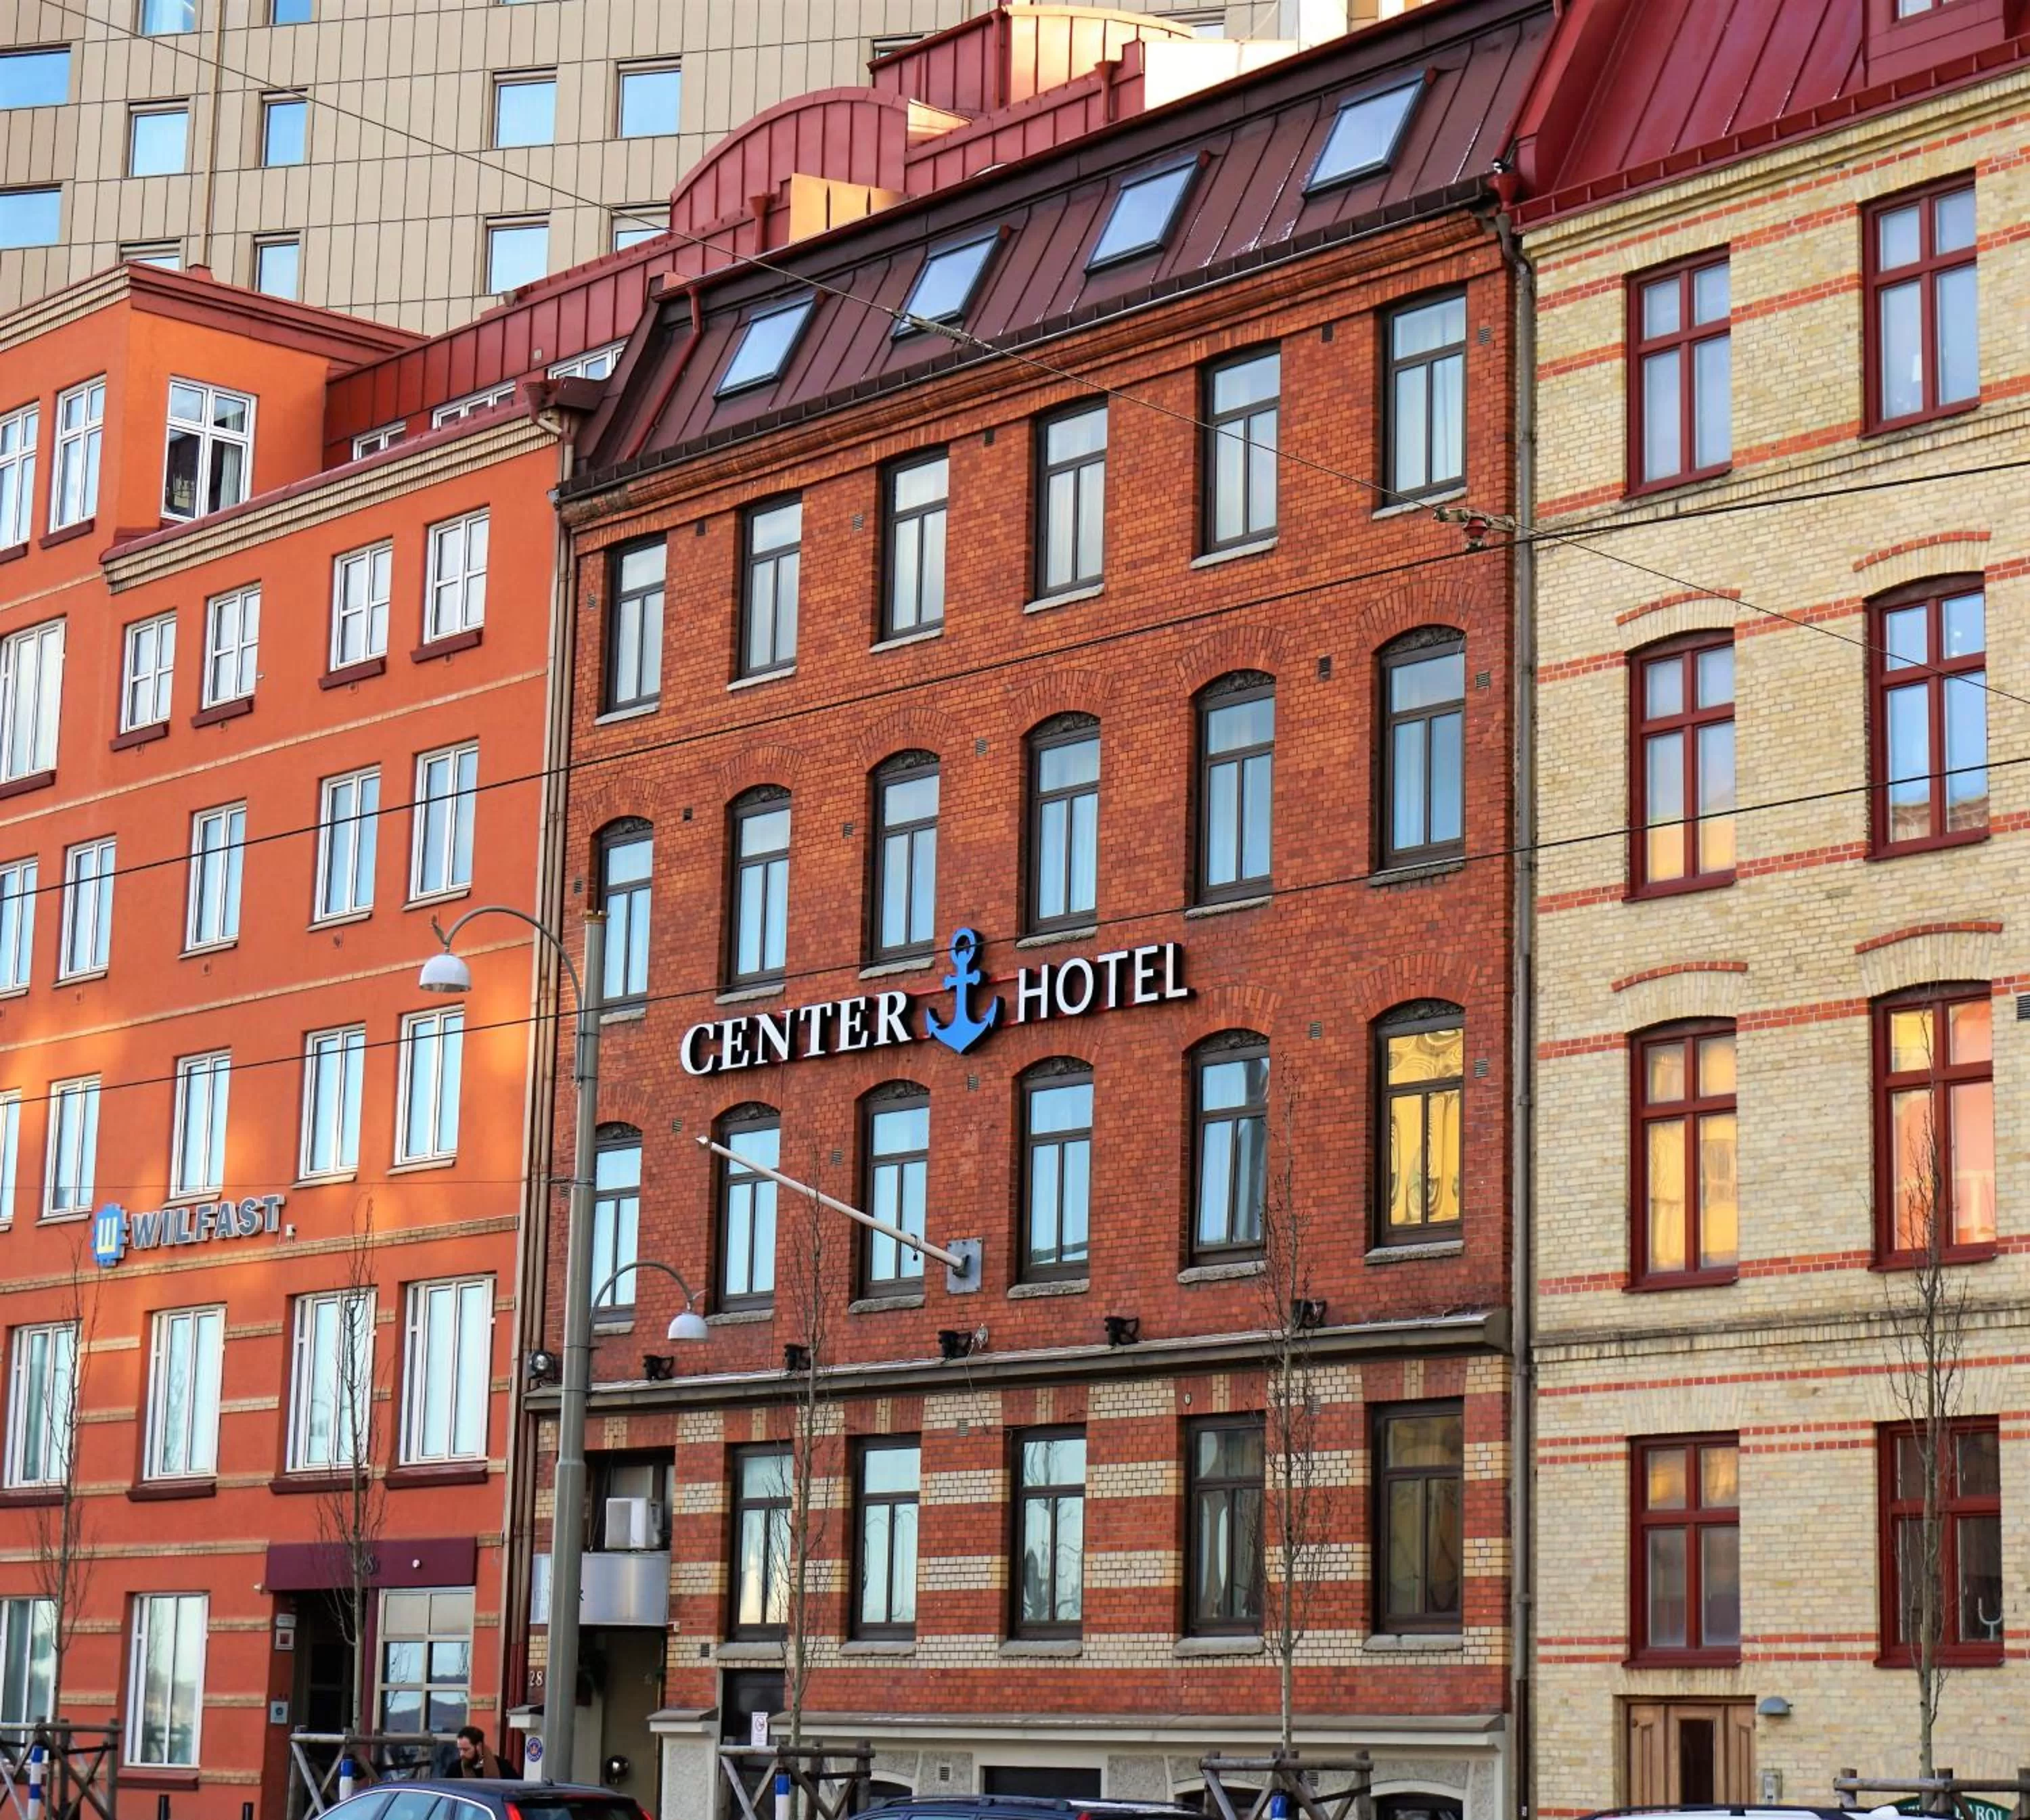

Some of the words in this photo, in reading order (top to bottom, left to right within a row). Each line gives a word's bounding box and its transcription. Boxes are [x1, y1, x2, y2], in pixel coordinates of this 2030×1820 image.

[680, 991, 912, 1075] CENTER
[1017, 942, 1188, 1022] HOTEL
[131, 1195, 284, 1249] WILFAST
[530, 1670, 543, 1686] 28
